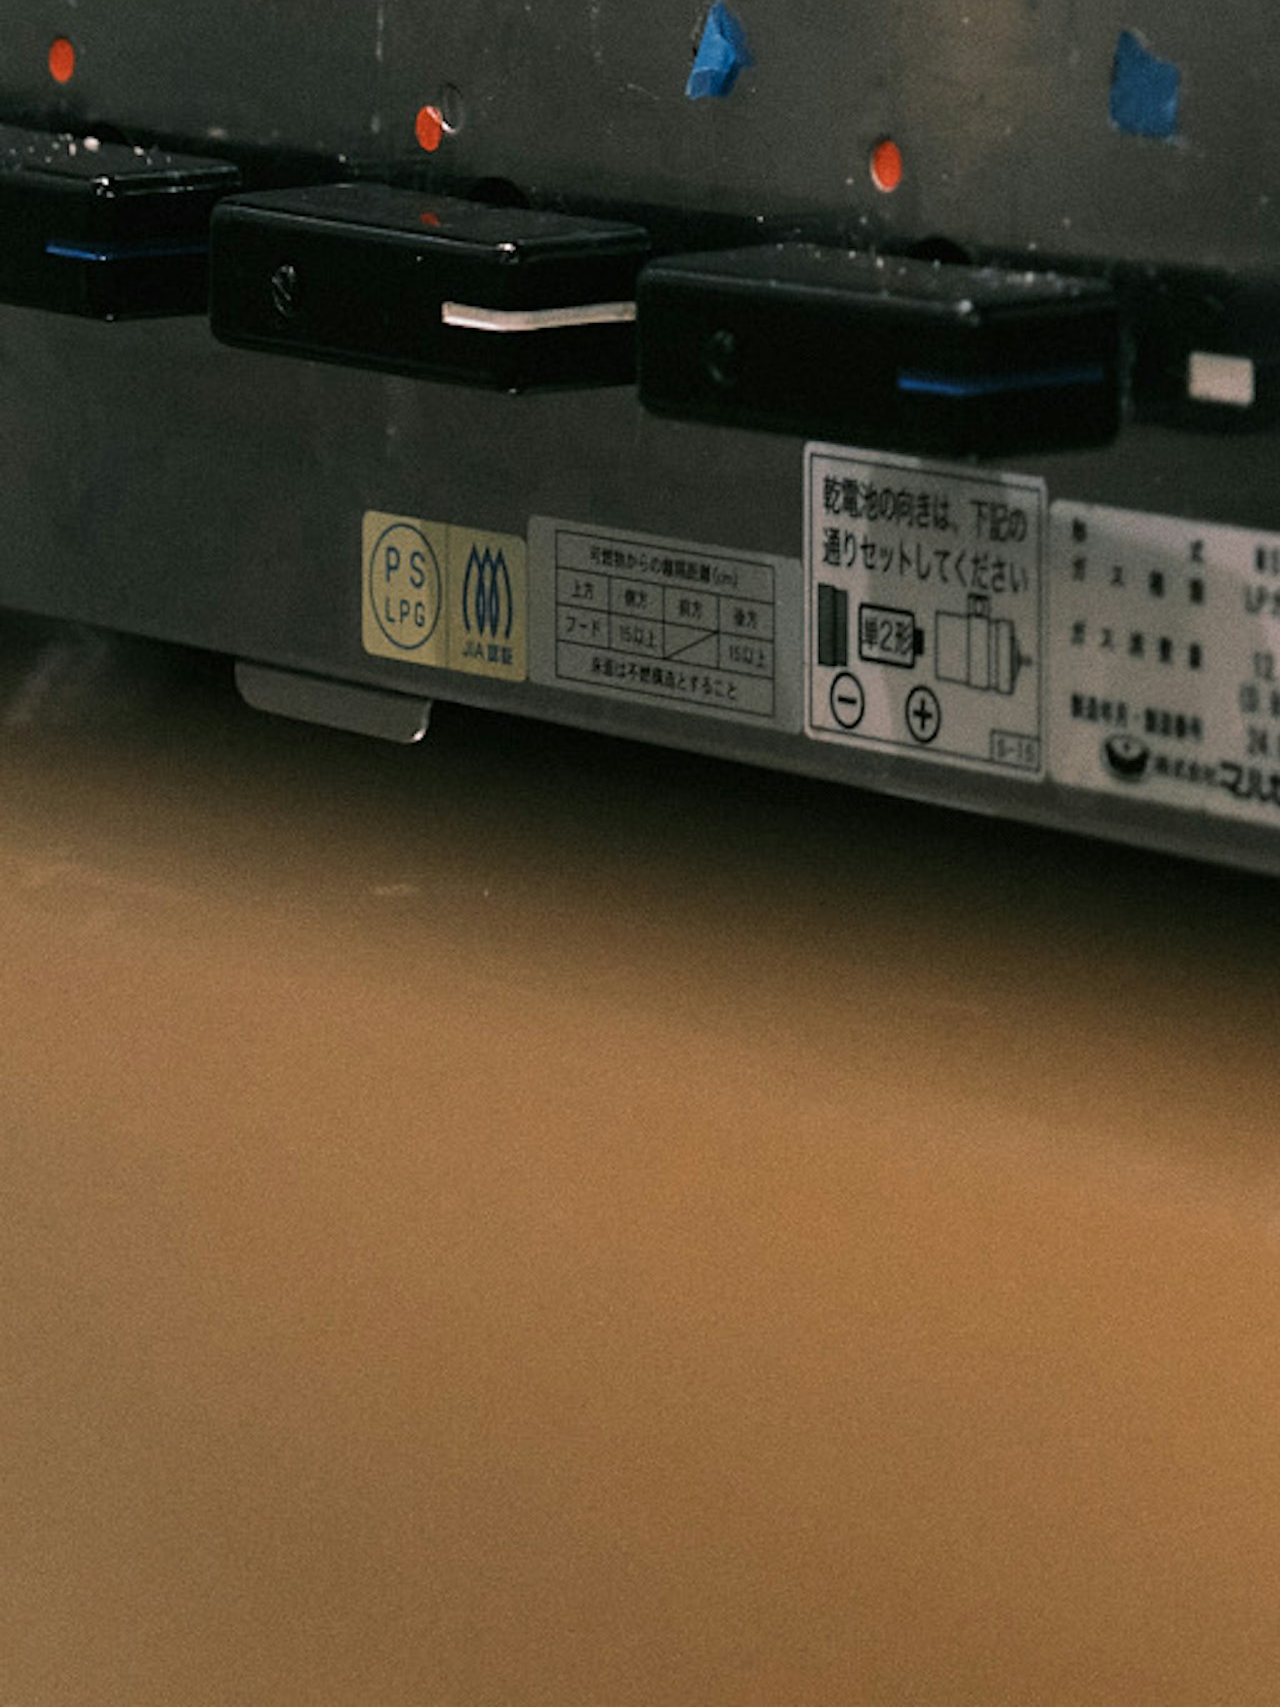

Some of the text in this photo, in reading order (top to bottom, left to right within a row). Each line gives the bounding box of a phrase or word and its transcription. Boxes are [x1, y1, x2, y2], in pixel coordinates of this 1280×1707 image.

[386, 546, 426, 588] PS
[821, 526, 1029, 594] 通りセットしてください
[385, 596, 426, 628] LPG
[564, 615, 601, 637] フード
